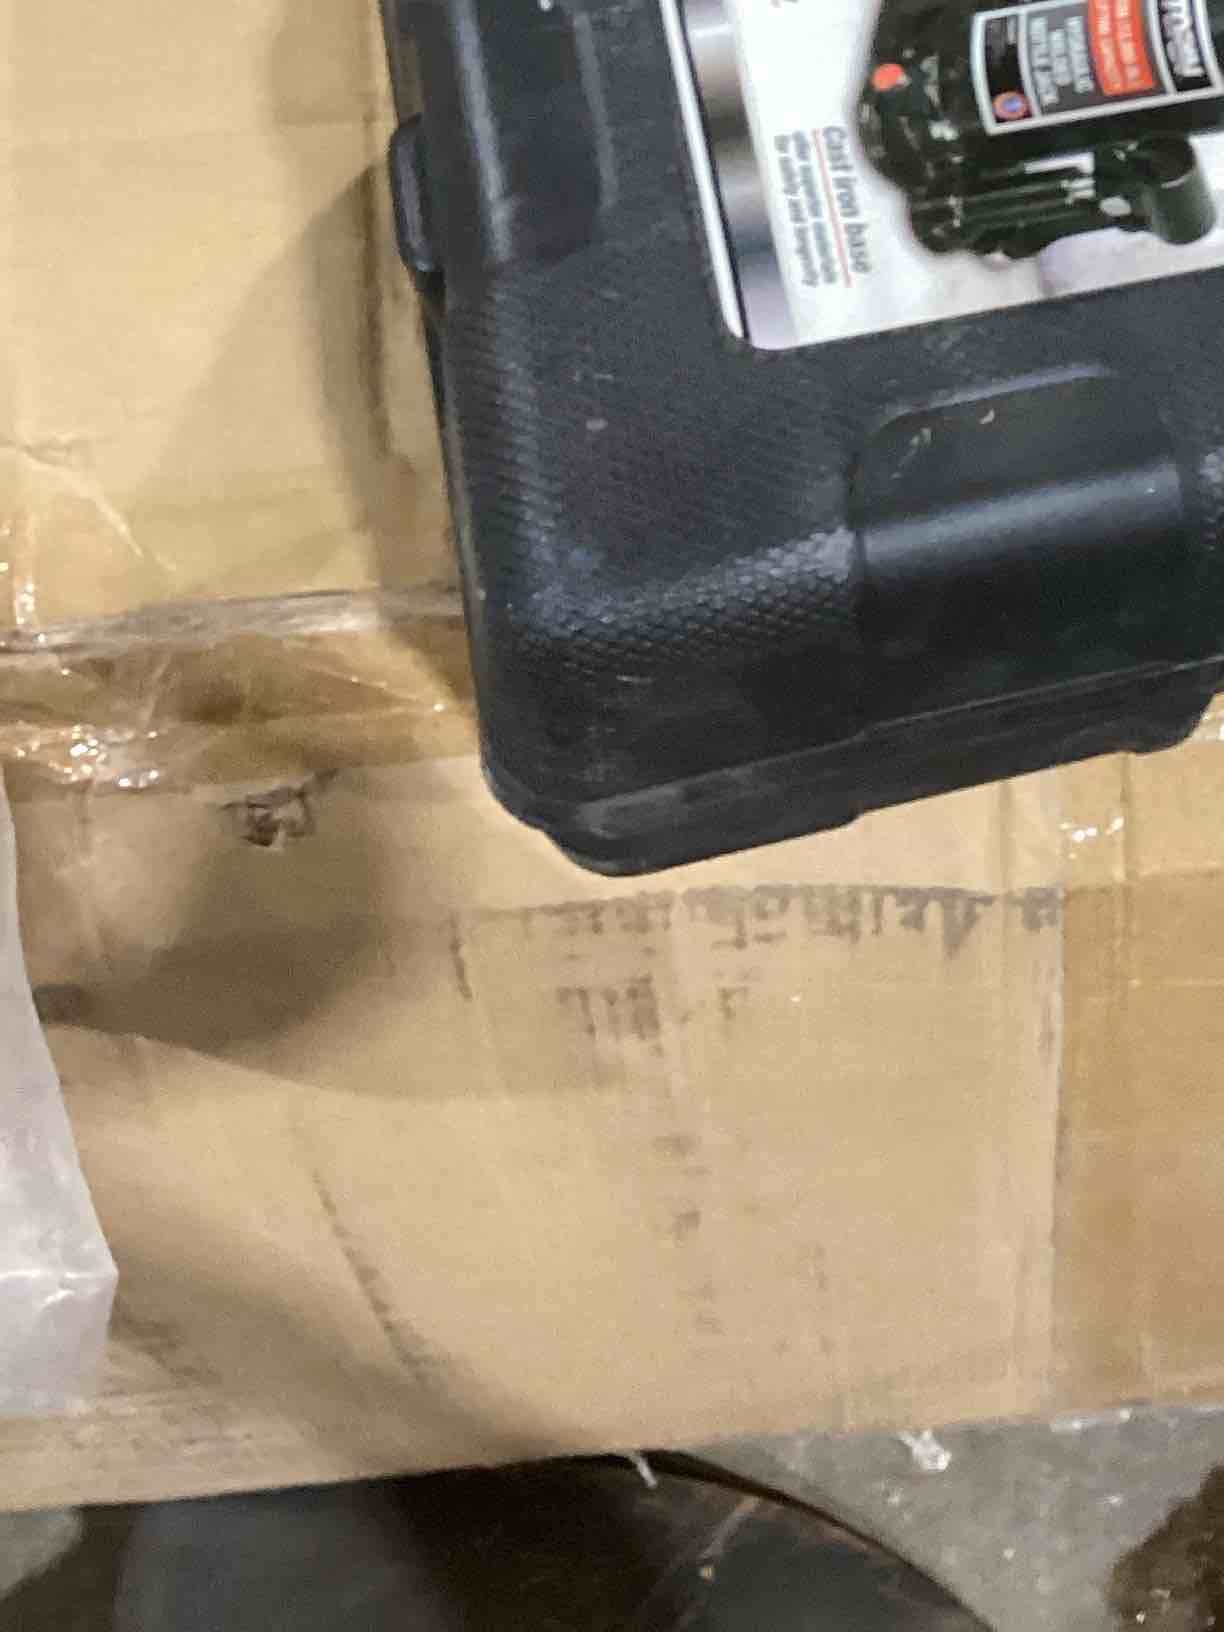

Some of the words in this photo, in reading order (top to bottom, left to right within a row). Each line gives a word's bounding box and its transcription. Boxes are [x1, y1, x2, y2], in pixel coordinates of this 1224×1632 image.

[822, 125, 853, 173] Cast
[833, 174, 862, 218] iron
[844, 222, 875, 275] base
